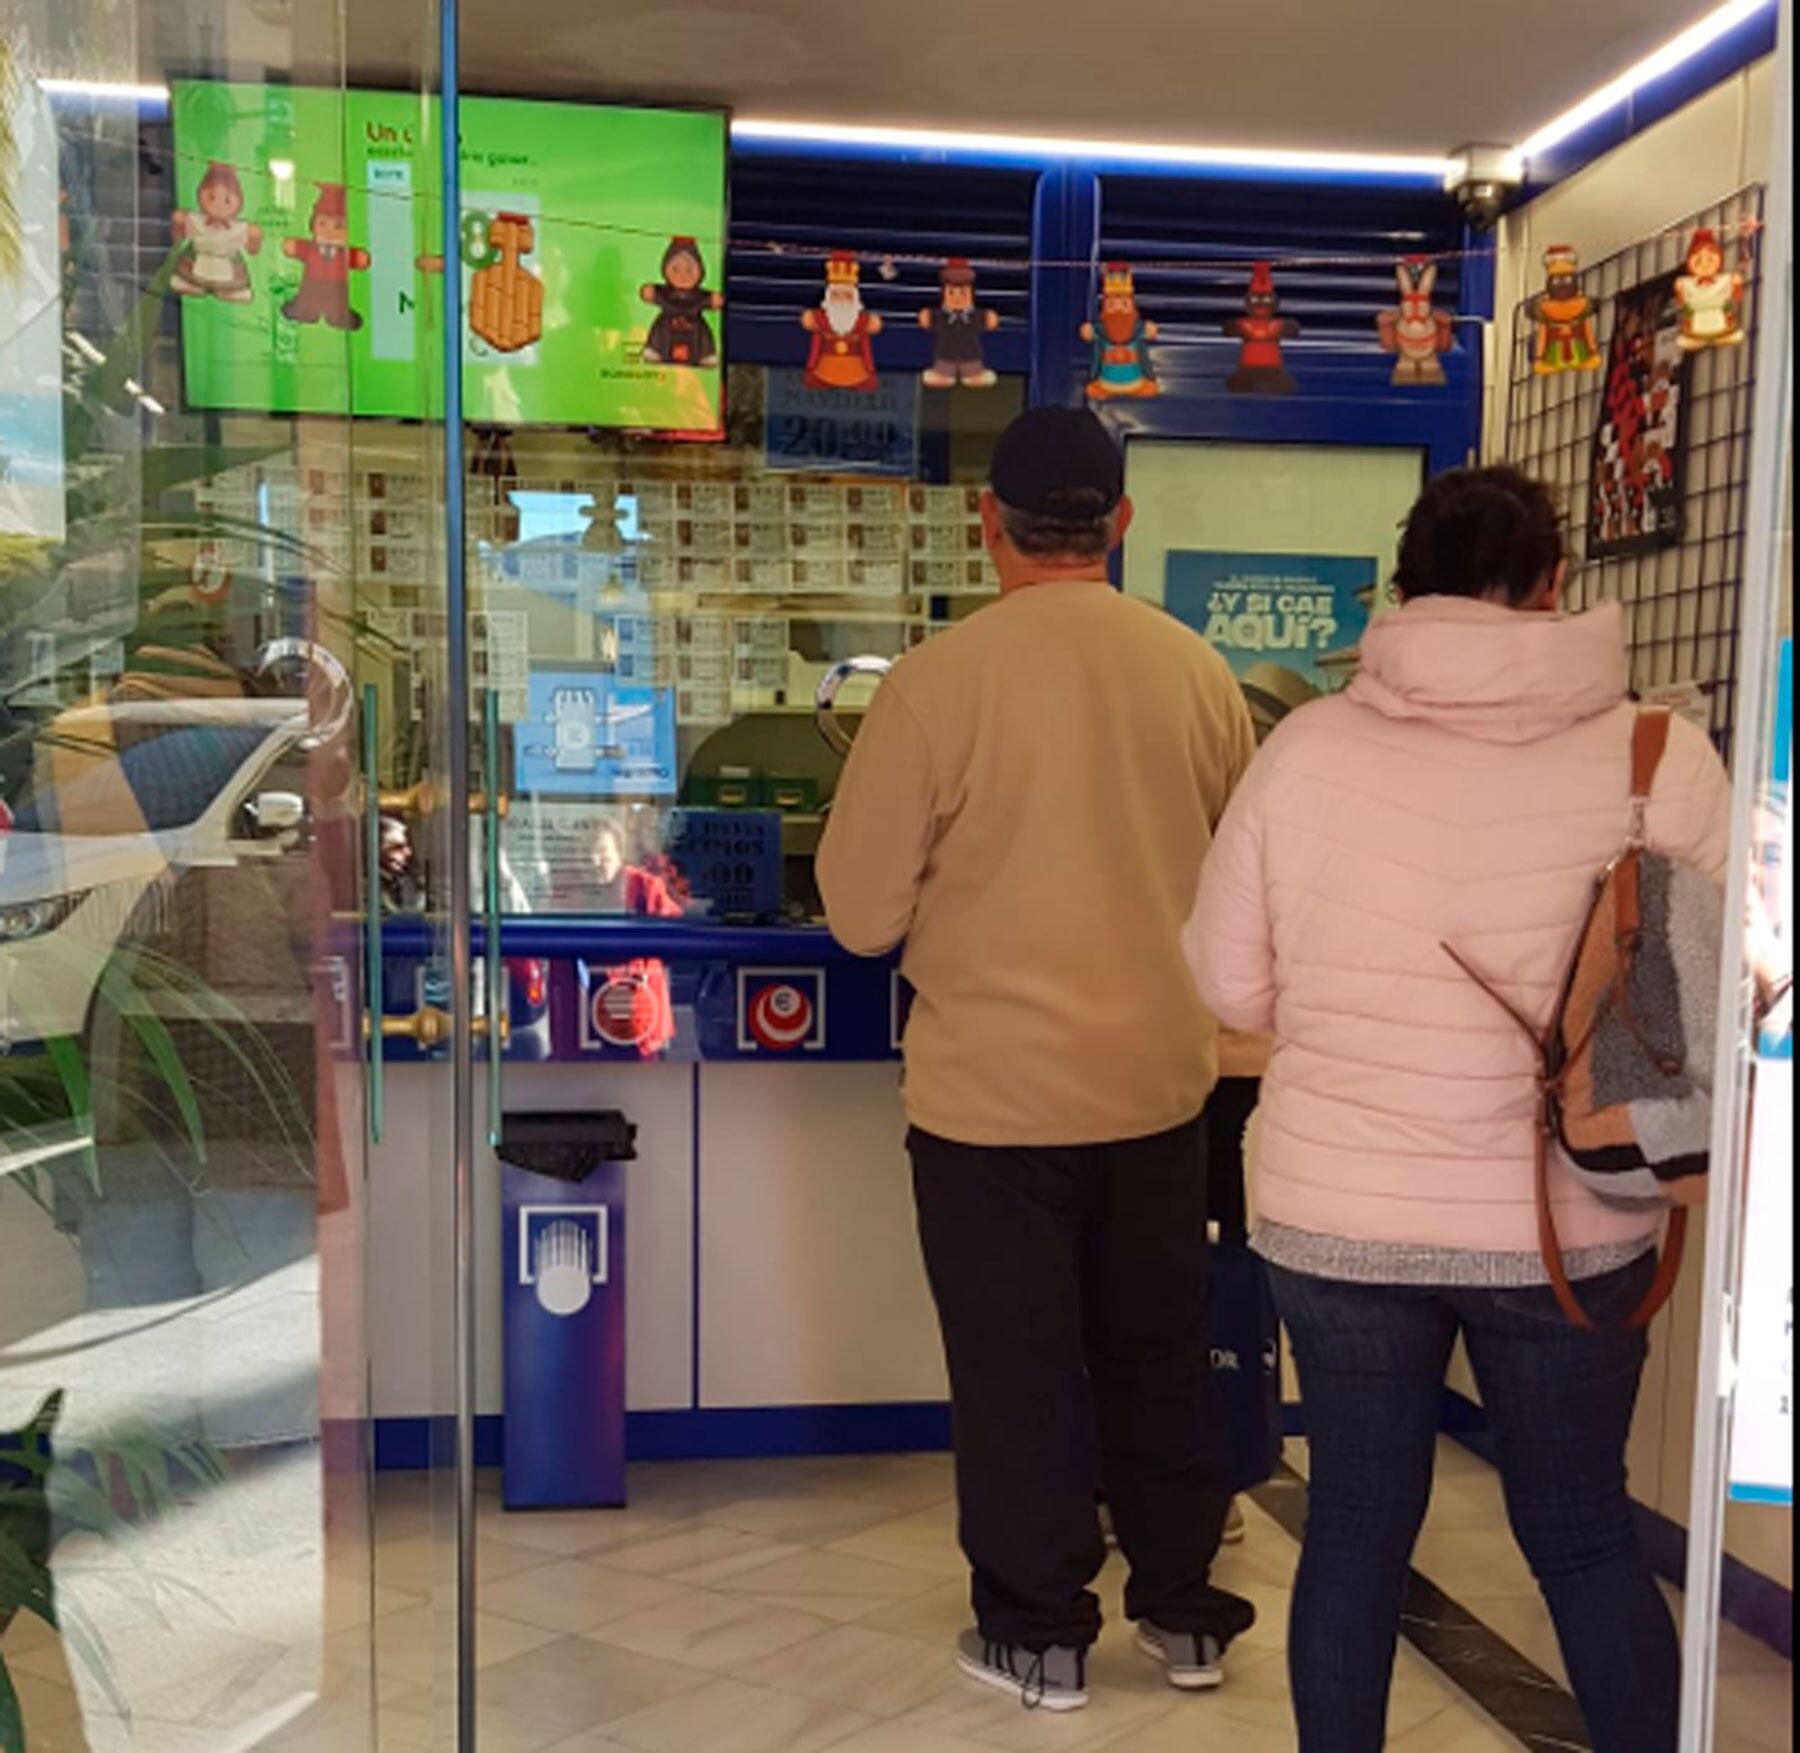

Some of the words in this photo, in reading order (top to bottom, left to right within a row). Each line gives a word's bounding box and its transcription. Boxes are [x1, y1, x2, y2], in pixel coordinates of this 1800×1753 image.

[1246, 593, 1272, 614] SI
[1276, 595, 1334, 616] CAE
[1203, 612, 1338, 651] AQUÍ?
